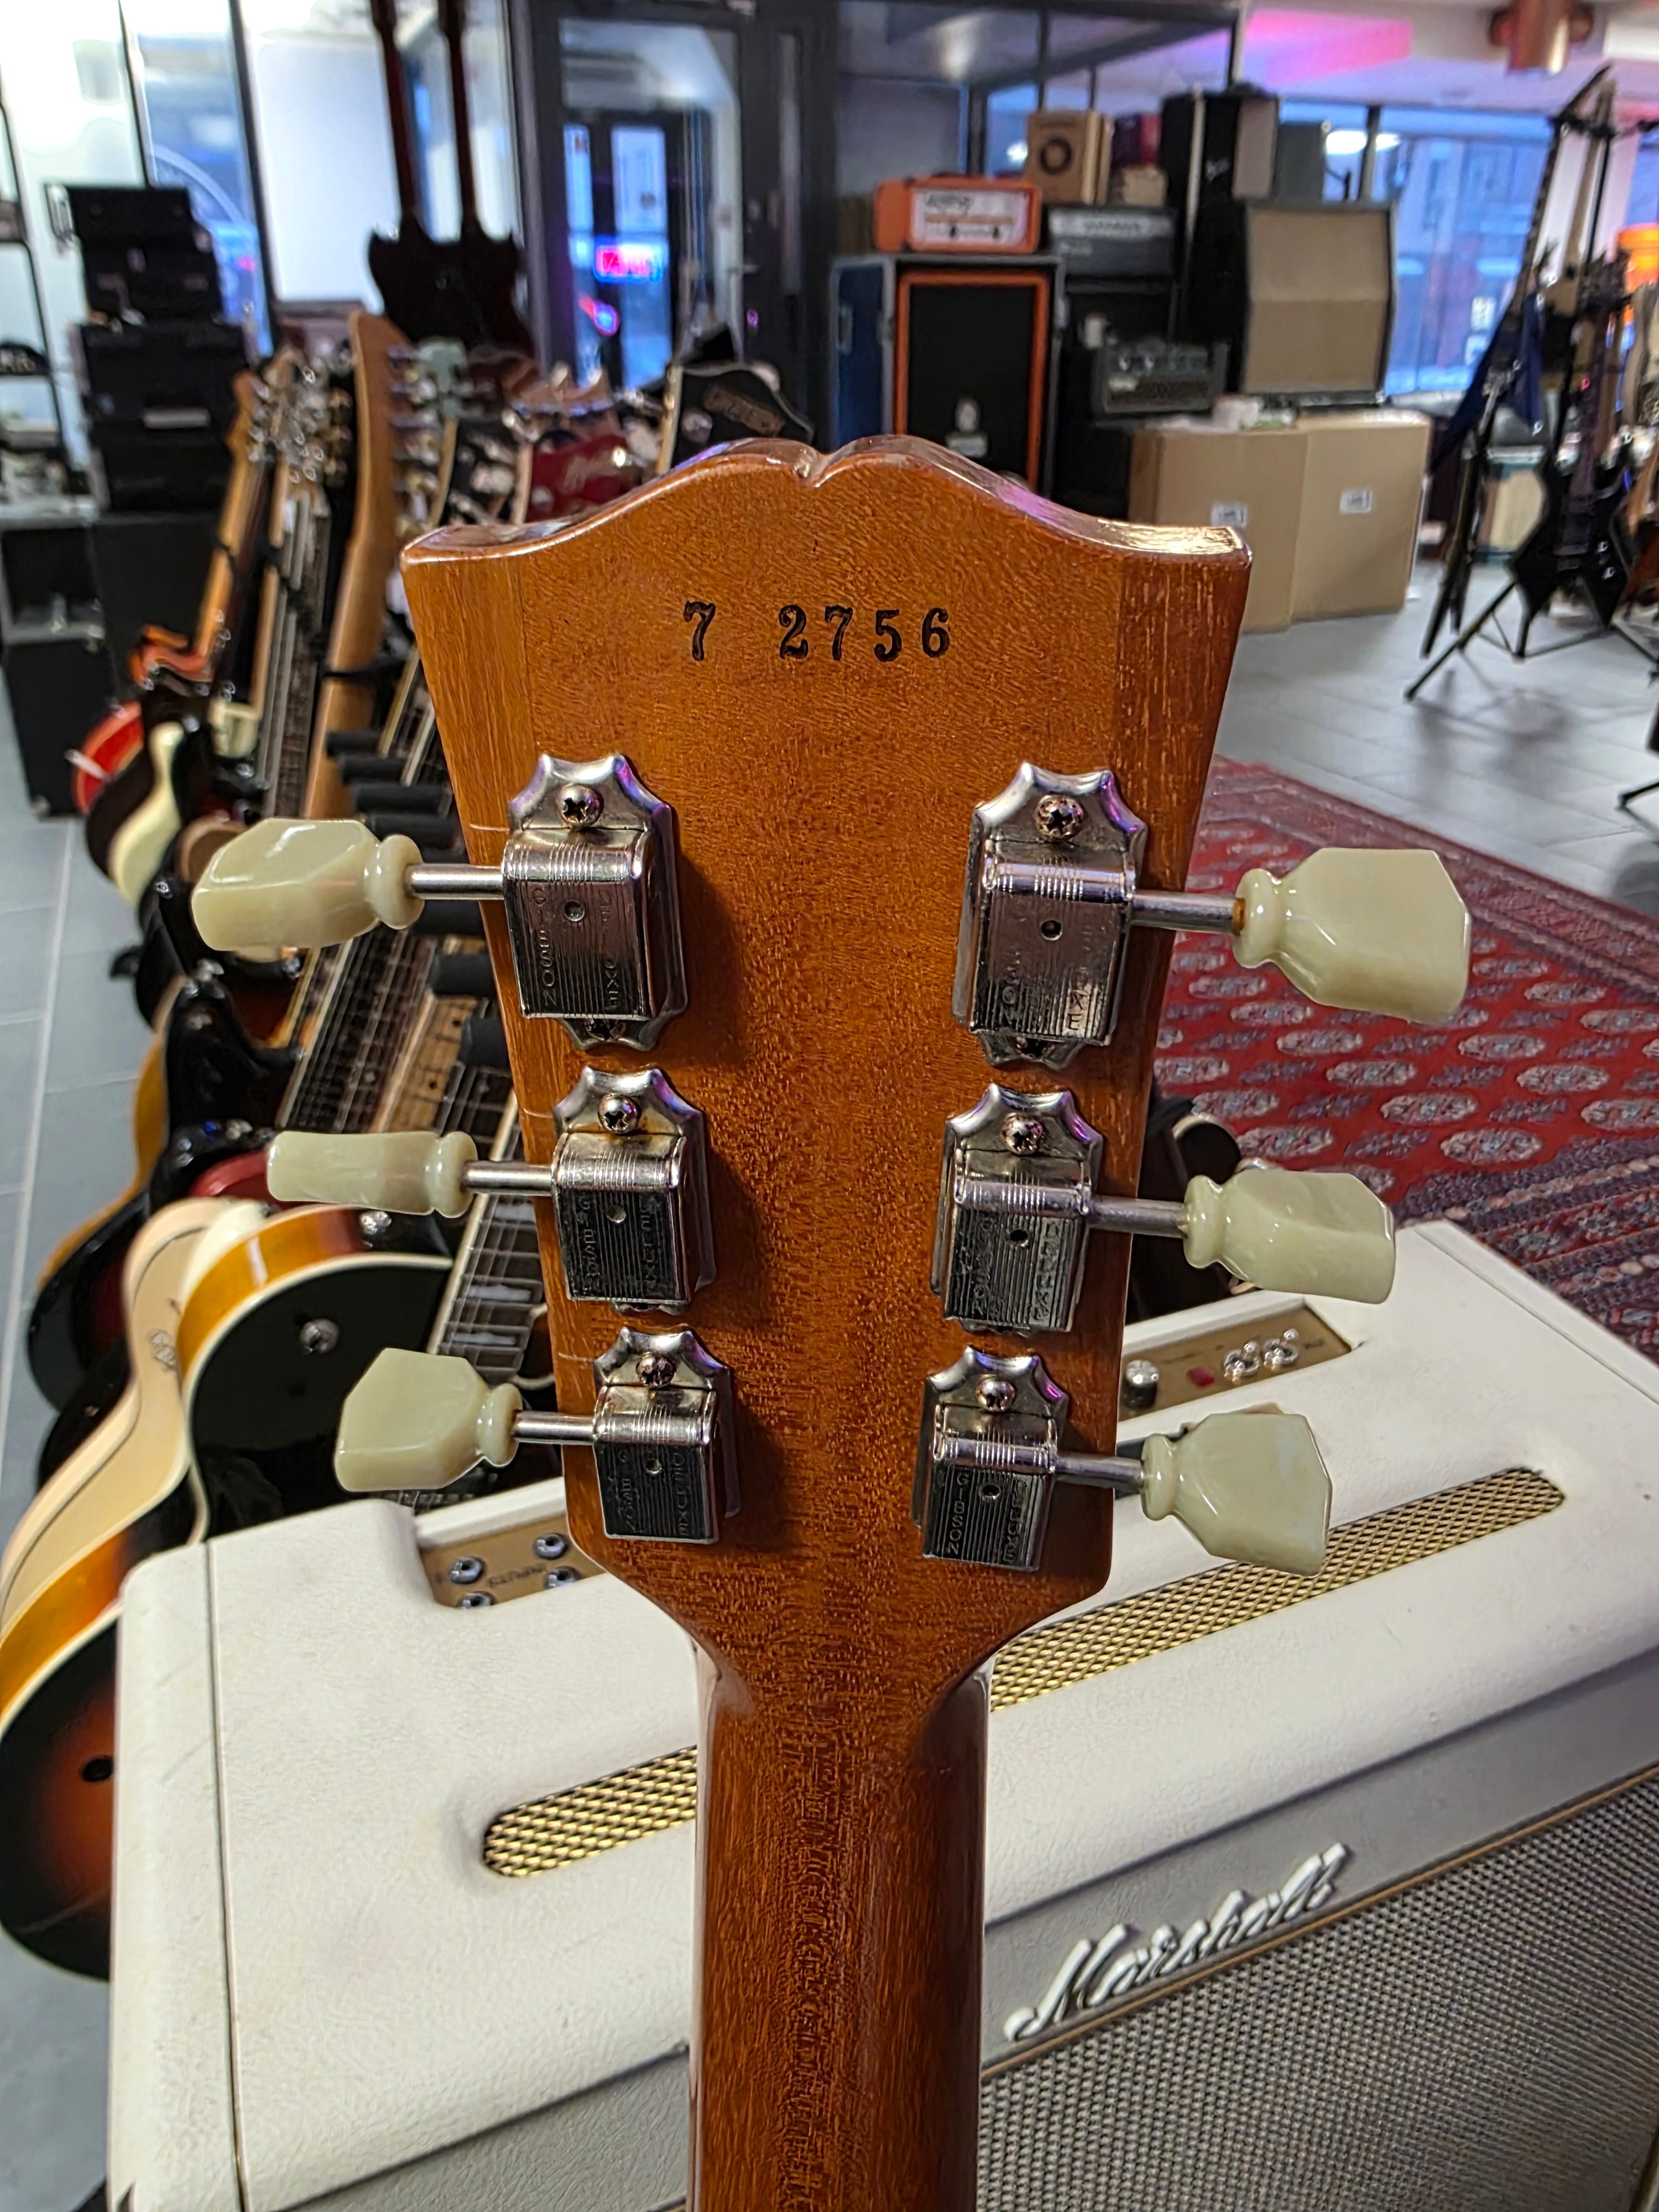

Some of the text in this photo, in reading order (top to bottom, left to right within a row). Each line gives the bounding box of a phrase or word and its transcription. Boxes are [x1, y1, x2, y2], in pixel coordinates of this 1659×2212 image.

[684, 601, 952, 662] 7 2756
[946, 1472, 971, 1556] GIBSON
[1002, 1842, 1347, 2041] Marshall
